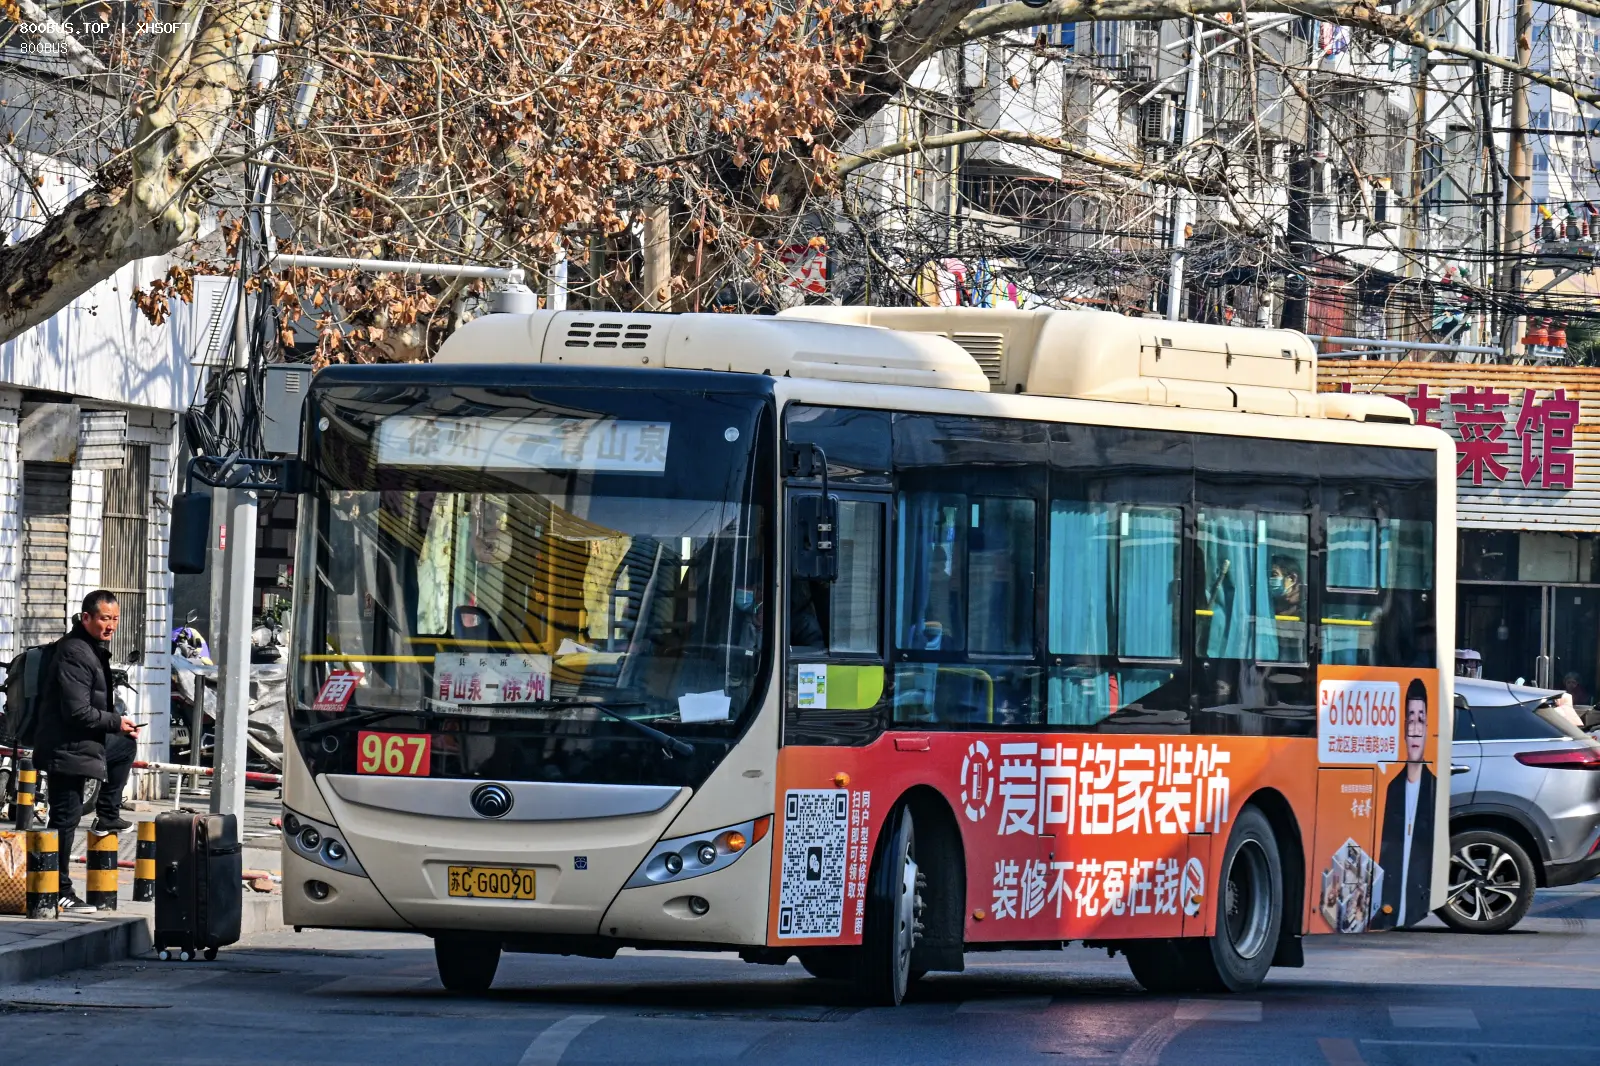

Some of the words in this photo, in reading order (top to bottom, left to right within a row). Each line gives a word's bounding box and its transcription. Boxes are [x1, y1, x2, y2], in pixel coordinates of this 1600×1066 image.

[407, 416, 482, 458] 徐州
[559, 418, 666, 464] 青山泉
[1341, 382, 1580, 489] 菜馆
[317, 672, 360, 703] 南
[1329, 689, 1397, 727] 61661666
[362, 734, 426, 775] 967
[996, 742, 1231, 835] 爱尚铭家装饰
[847, 791, 861, 898] 扫码即可领取
[854, 791, 871, 935] 同户型装修效果图
[991, 857, 1180, 920] 装修不花冤枉钱
